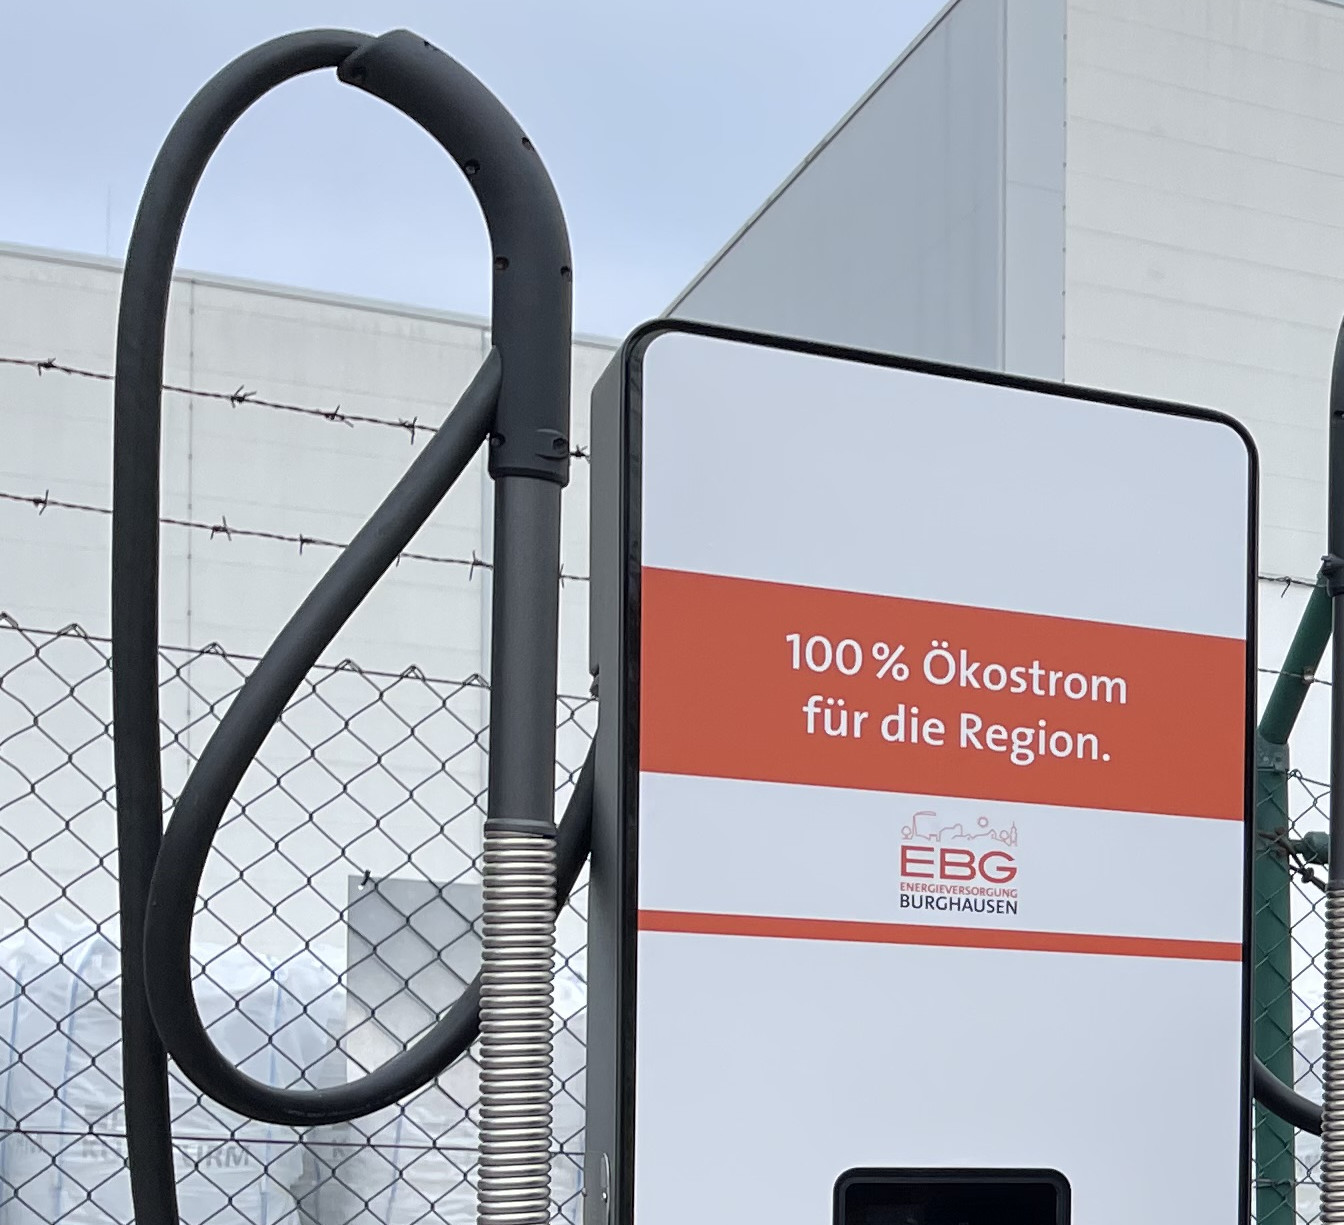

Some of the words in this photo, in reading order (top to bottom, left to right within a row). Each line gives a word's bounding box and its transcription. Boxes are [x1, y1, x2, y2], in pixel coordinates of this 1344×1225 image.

[785, 633, 863, 676] 100
[872, 641, 910, 681] %
[922, 639, 1128, 705] Ökostrom
[803, 695, 868, 739] für
[881, 704, 946, 747] die
[959, 714, 1112, 767] Region.
[900, 845, 1018, 884] EBG
[899, 881, 1018, 899] ENERGIEVERSORGUNG
[899, 894, 1018, 915] BURGHAUSEN
